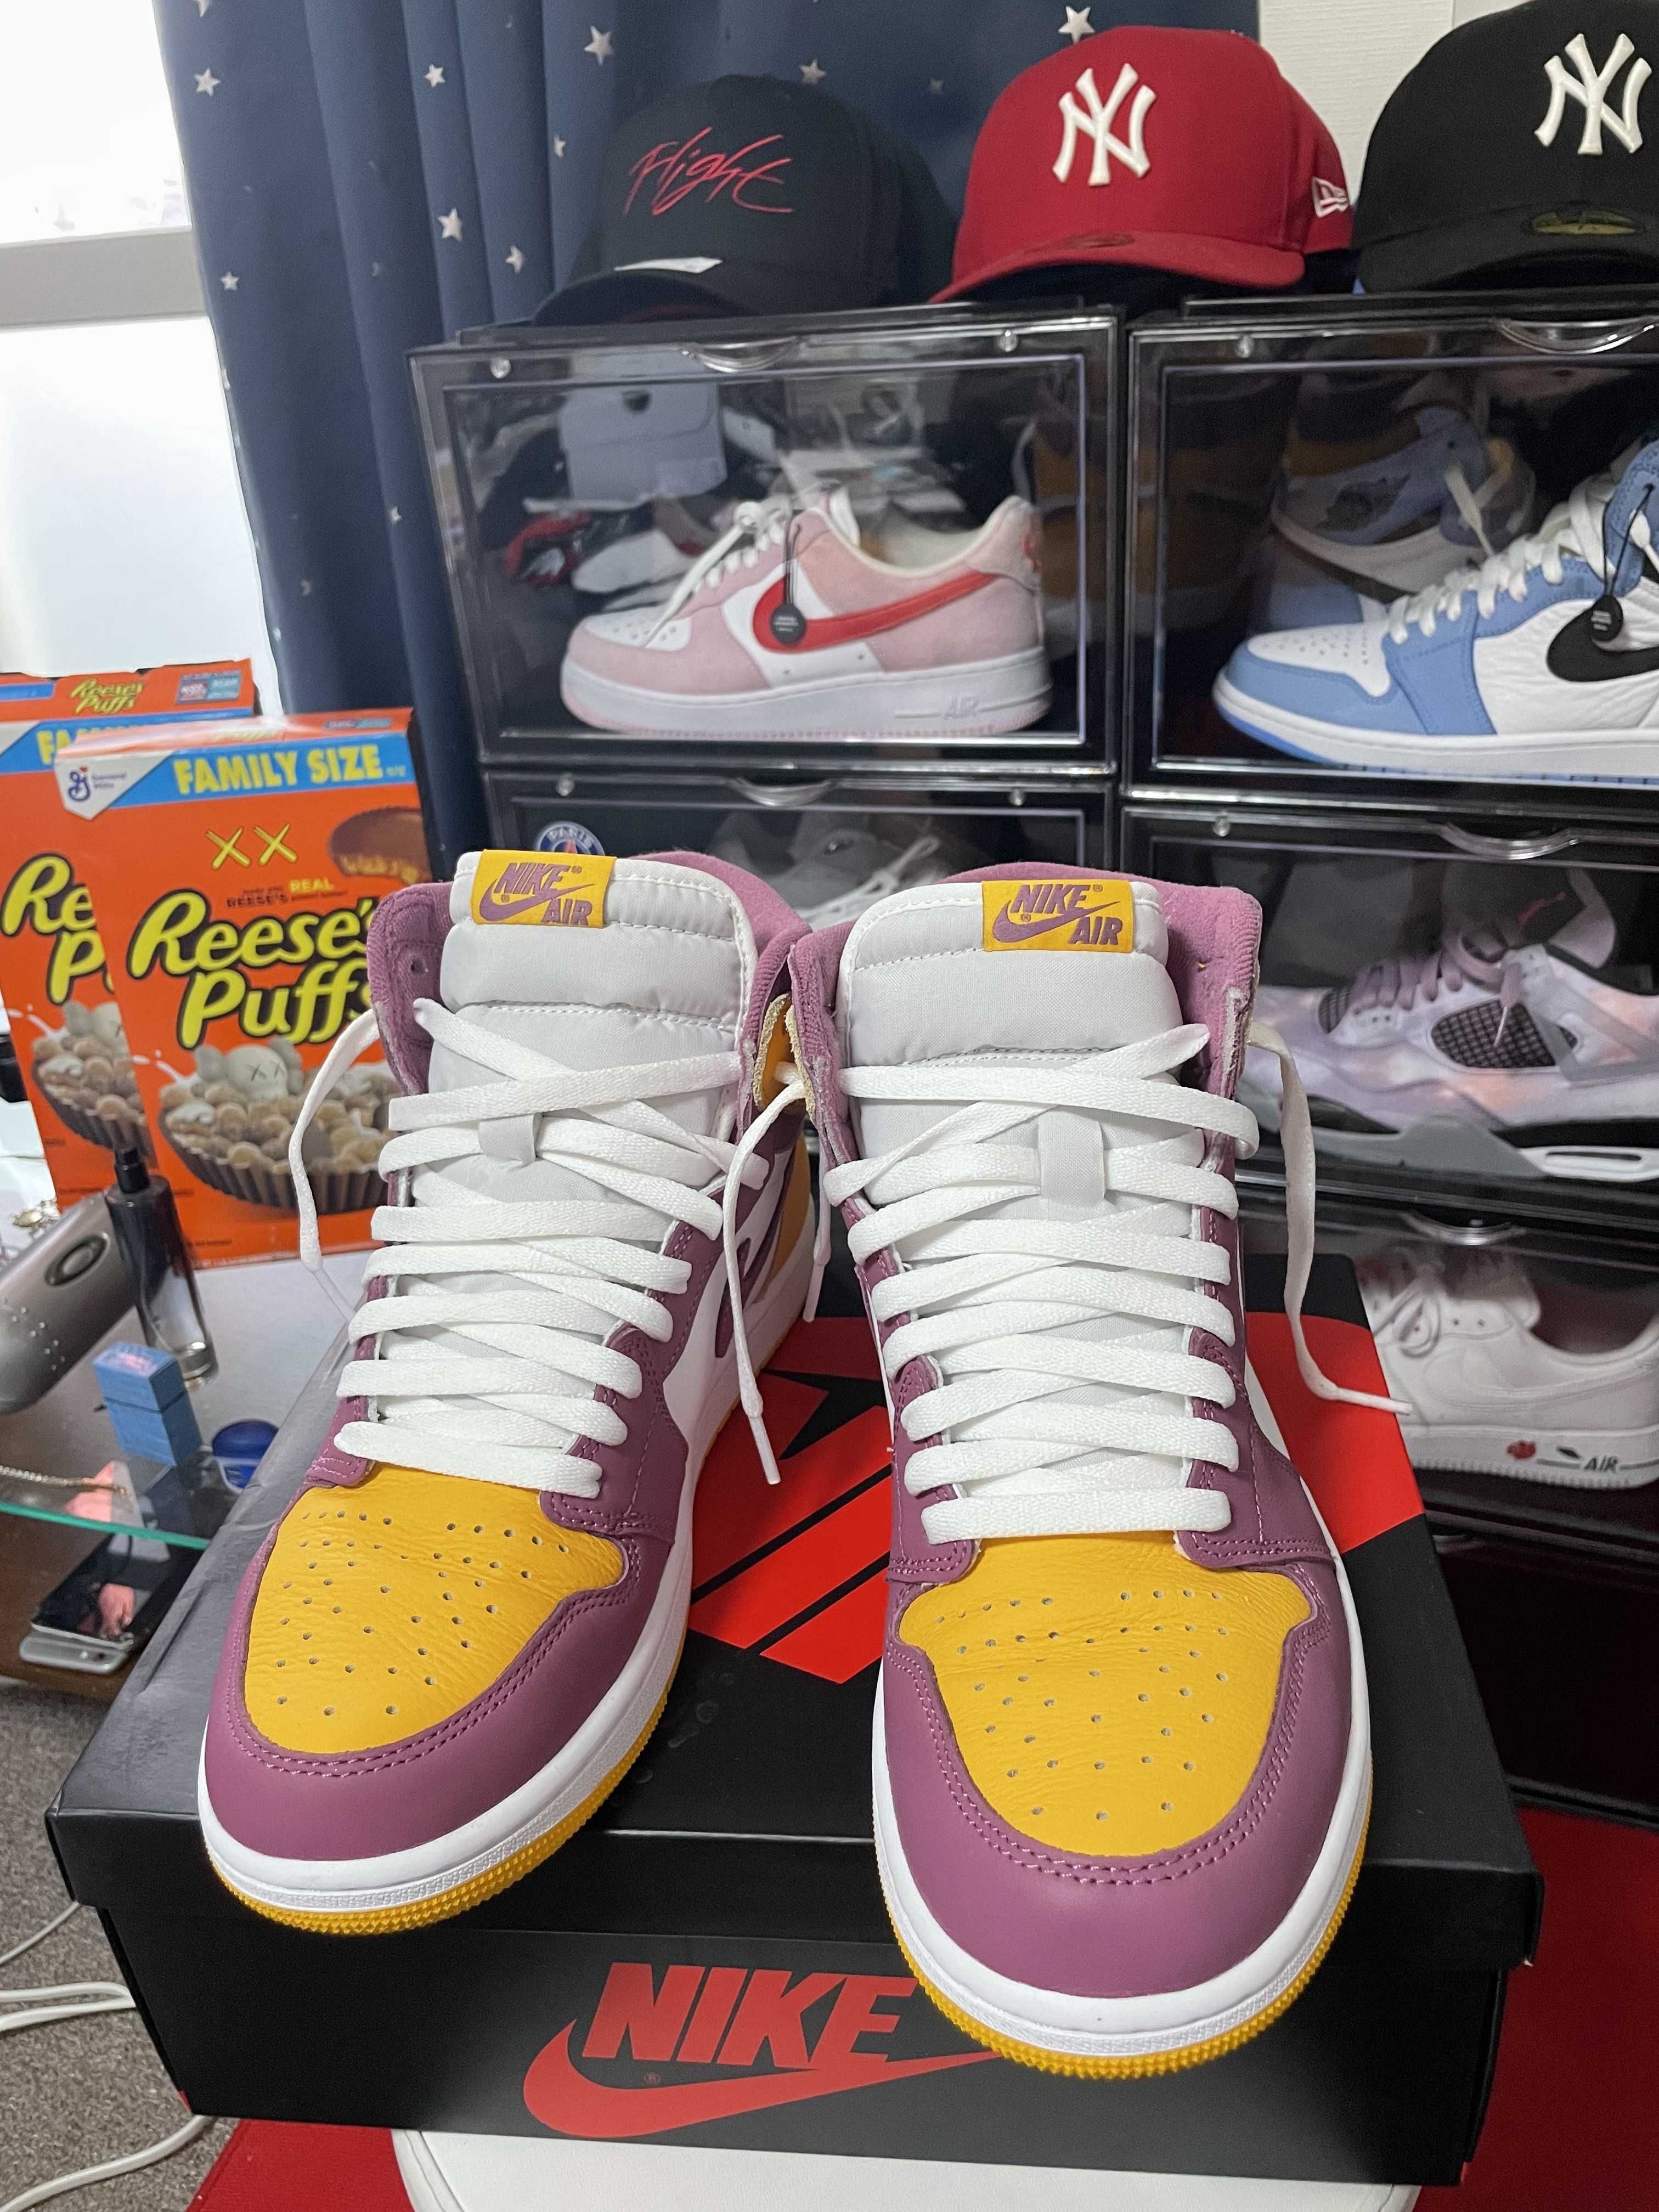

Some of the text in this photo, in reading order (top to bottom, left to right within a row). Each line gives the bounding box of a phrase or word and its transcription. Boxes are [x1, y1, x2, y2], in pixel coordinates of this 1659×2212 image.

[1534, 33, 1652, 156] NY
[1052, 63, 1156, 187] NY
[623, 126, 792, 216] Flight
[75, 697, 136, 715] Puffs
[173, 751, 298, 795] FAMILY
[307, 744, 383, 783] SIZE
[289, 877, 334, 893] REAL
[494, 859, 572, 895] NIKE
[541, 898, 593, 926] AIR
[1010, 884, 1091, 915] NIKE
[128, 890, 376, 978] Reese'
[1069, 916, 1124, 945] AIR
[1583, 1455, 1618, 1472] AIR
[582, 1962, 918, 2070] NIKE
